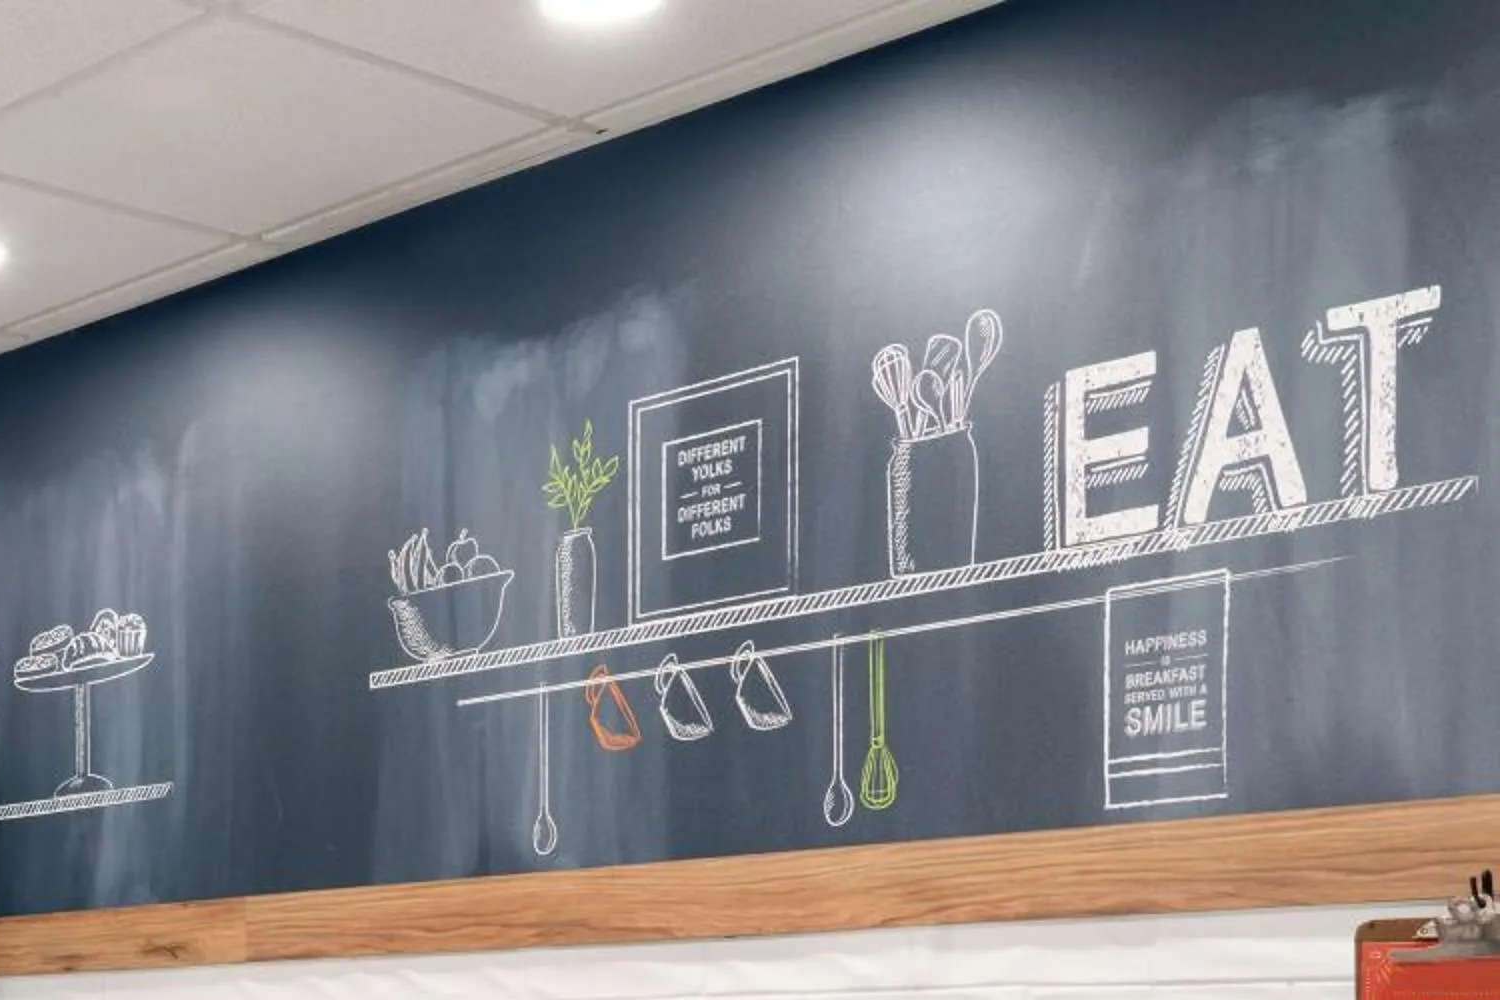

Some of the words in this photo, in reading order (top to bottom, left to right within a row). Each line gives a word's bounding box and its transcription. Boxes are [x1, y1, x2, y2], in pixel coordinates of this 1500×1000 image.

[1046, 285, 1441, 548] EAT
[677, 435, 747, 467] DIFFERENT
[691, 459, 733, 482] YOLKS
[701, 483, 721, 498] FOR
[677, 493, 747, 523] DIFFERENT
[691, 516, 732, 539] FOLKS
[1125, 629, 1208, 656] HAPPINESS
[1125, 664, 1207, 689] BREAKFAST
[1124, 688, 1166, 705] SERVED
[1168, 683, 1198, 699] WITH
[1199, 683, 1208, 696] A
[1124, 699, 1208, 739] SMILE
